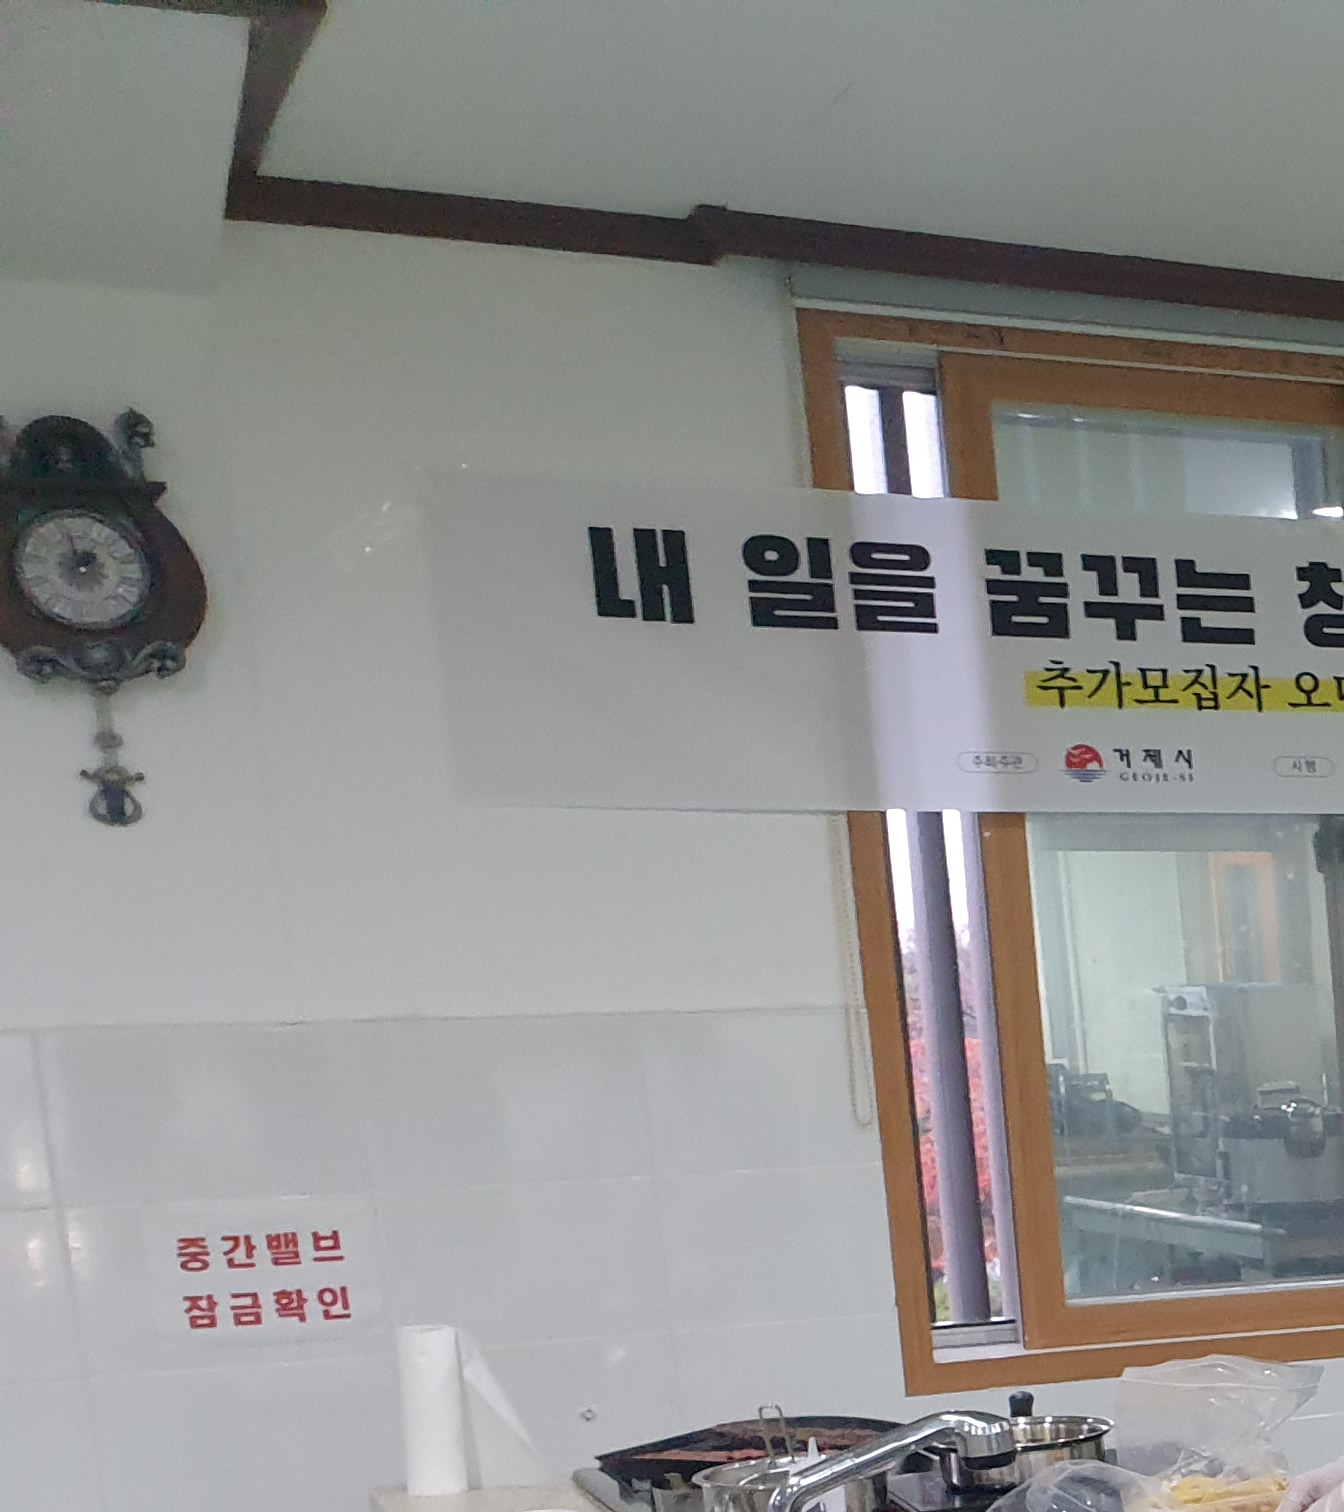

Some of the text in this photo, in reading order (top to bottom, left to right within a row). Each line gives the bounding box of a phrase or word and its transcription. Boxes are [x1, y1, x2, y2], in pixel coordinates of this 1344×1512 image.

[588, 526, 694, 624] 내
[742, 534, 939, 633] 일을
[984, 548, 1256, 645] 꿈꾸는
[1036, 659, 1271, 712] 추가모집자
[1113, 748, 1195, 768] 거제시
[176, 1229, 345, 1273] 중간밸브
[182, 1285, 352, 1330] 잠금확인
